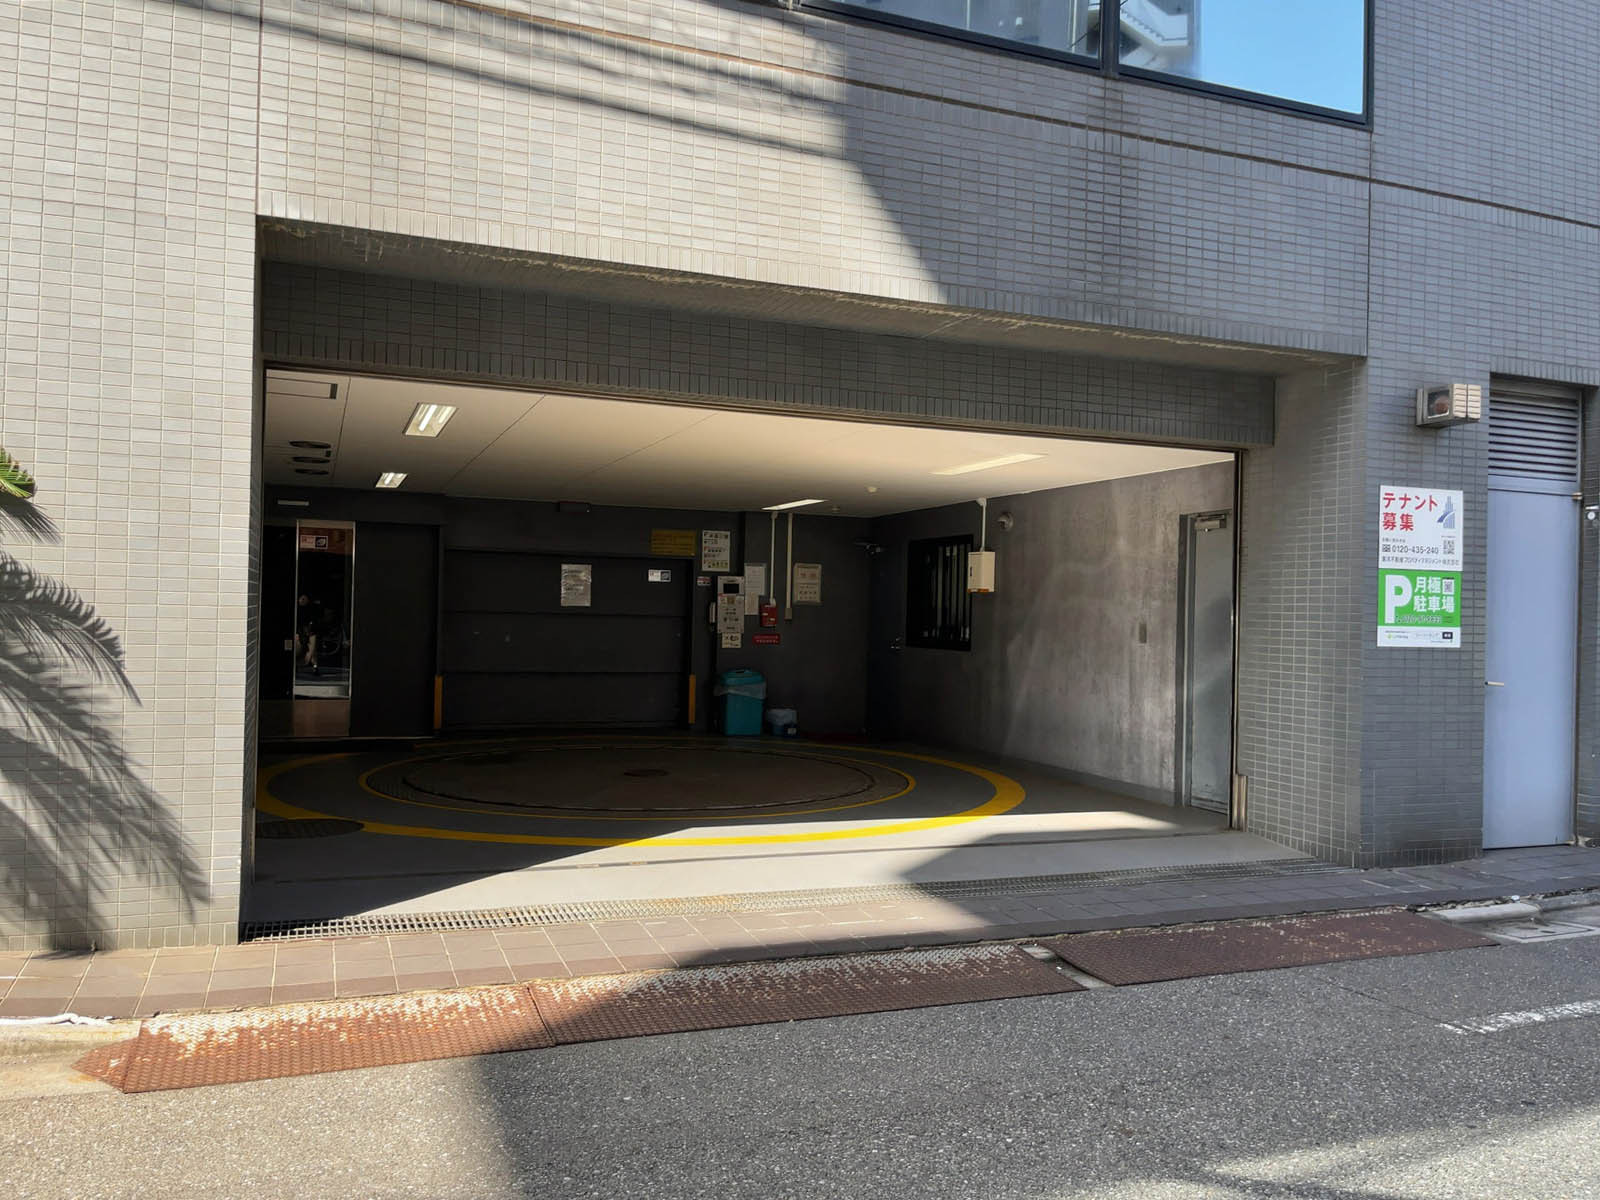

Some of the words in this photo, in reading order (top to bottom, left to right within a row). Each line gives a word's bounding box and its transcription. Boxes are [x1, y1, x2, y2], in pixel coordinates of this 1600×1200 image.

[1383, 492, 1438, 512] テナント
[1383, 512, 1414, 531] 募集
[1392, 545, 1439, 554] 0120-435-240
[1414, 576, 1441, 594] 月極
[1385, 575, 1412, 624] P
[1413, 595, 1455, 613] 駐車場
